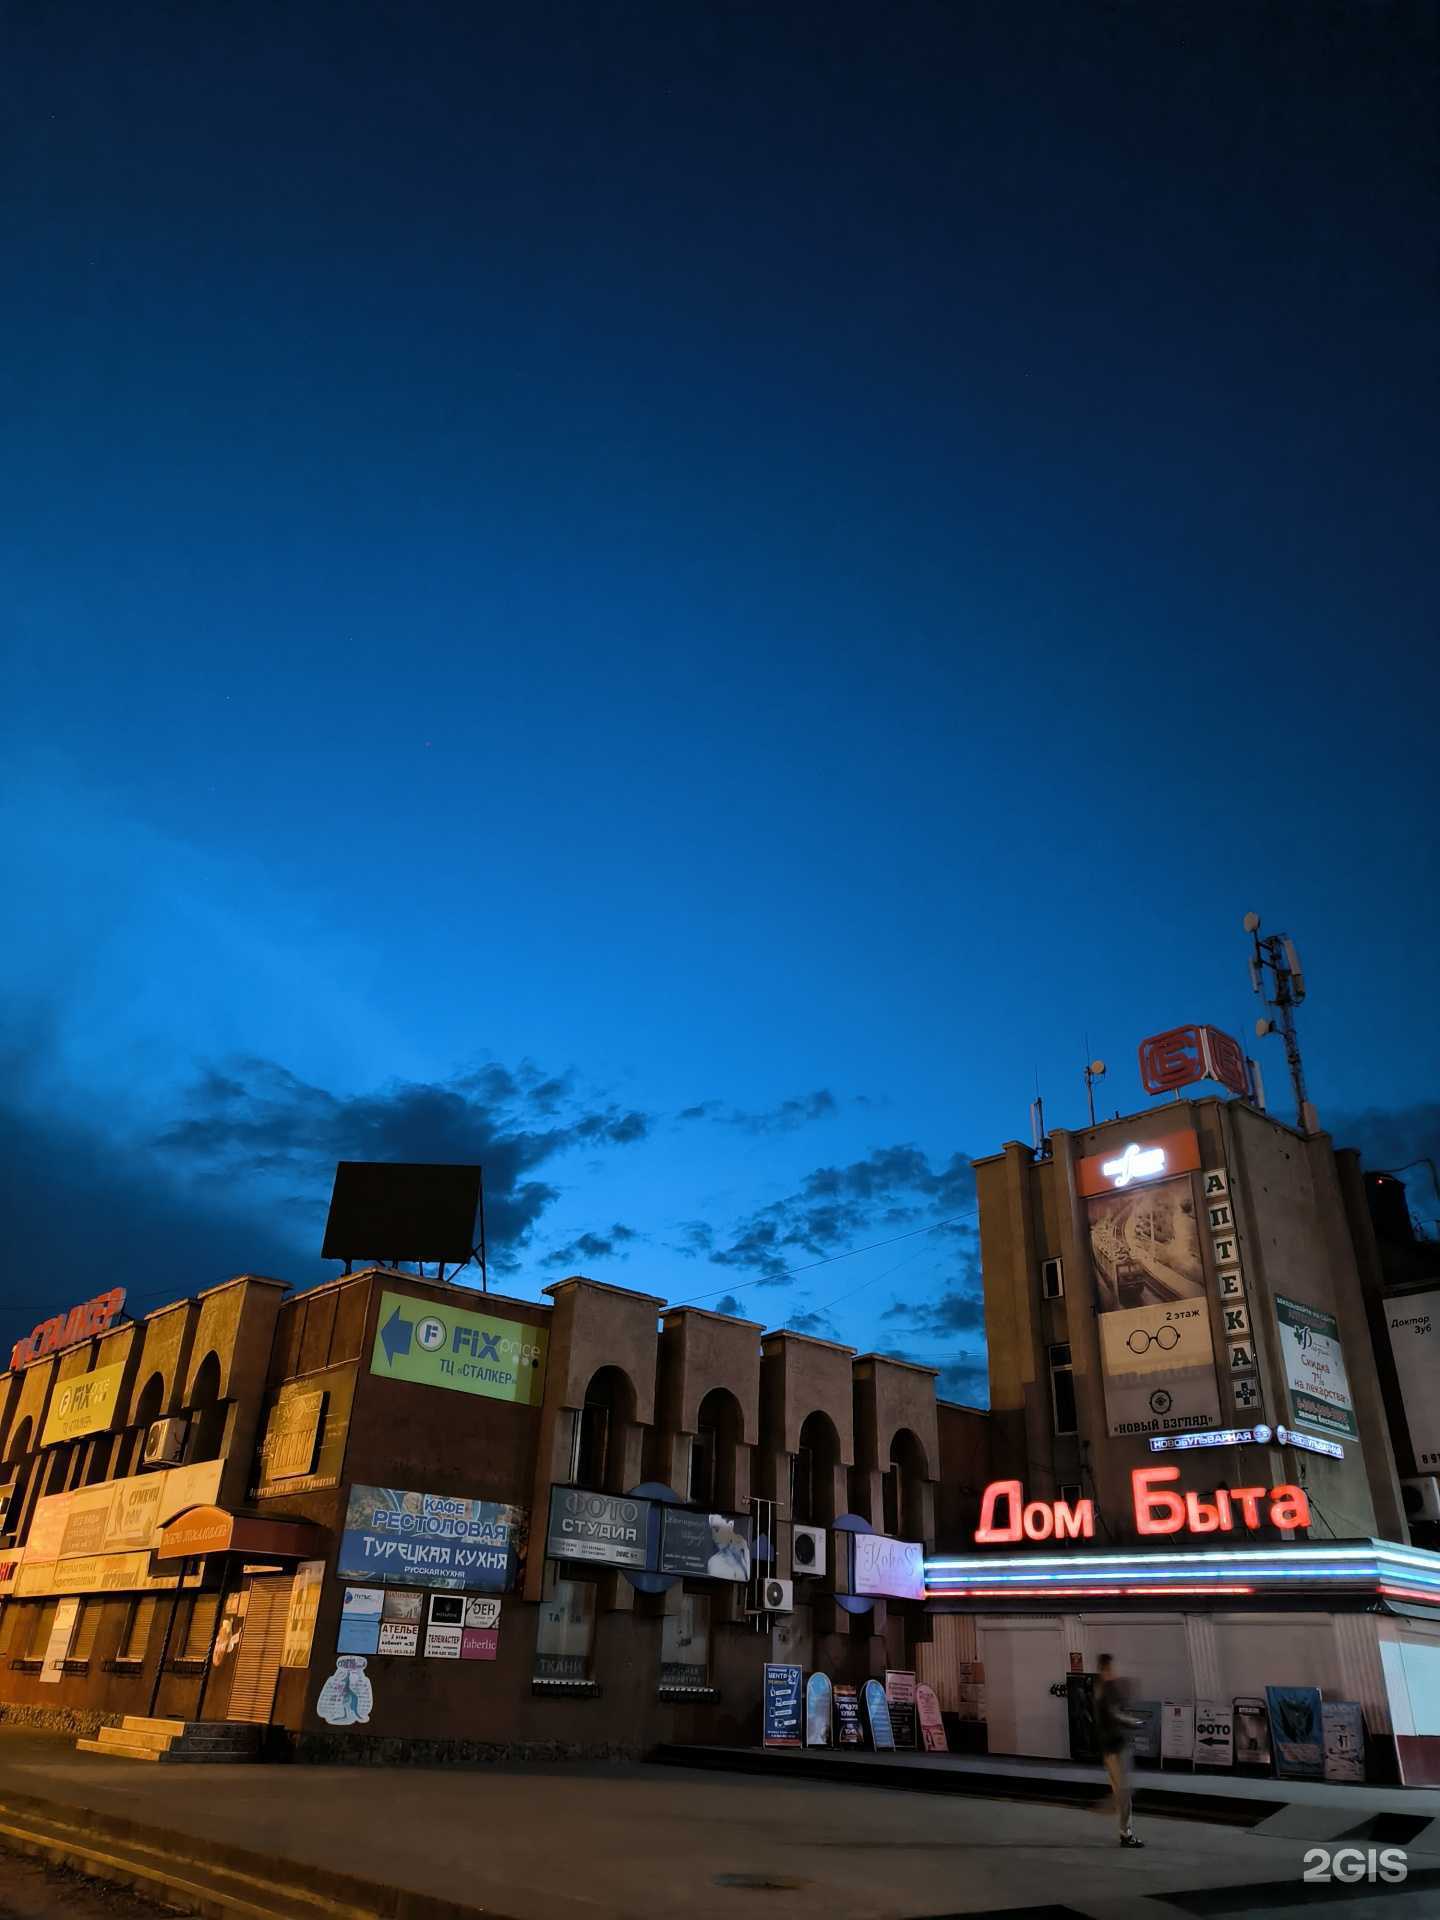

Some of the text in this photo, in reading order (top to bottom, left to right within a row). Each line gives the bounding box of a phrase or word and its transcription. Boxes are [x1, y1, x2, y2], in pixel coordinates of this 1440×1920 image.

[1206, 1175, 1251, 1367] АПТЕКА
[1165, 1309, 1200, 1320] 2 этаж
[1391, 1316, 1430, 1328] Доктор
[1414, 1325, 1432, 1336] Зуб
[440, 1358, 455, 1375] ТЦ
[1301, 1354, 1330, 1374] Скидка
[1305, 1382, 1346, 1406] лекарства
[1152, 1430, 1252, 1449] НОВОБУЛЬВАРНАЯ
[424, 1498, 465, 1515] КАФЕ
[566, 1493, 640, 1522] ФОТО
[974, 1466, 1312, 1544] Дом Быта
[372, 1510, 508, 1542] РЕСТОЛОВАЯ
[561, 1519, 639, 1542] СТУДИЯ
[454, 1548, 508, 1571] КУХНЯ
[404, 1566, 466, 1579] РУССКАЯ КУХНЯ
[382, 1624, 418, 1637] АТЕЛЬЕ
[428, 1634, 461, 1645] ТЕЛЕМАСТЕР
[463, 1638, 498, 1650] faberlic
[1196, 1724, 1231, 1736] ФОТО
